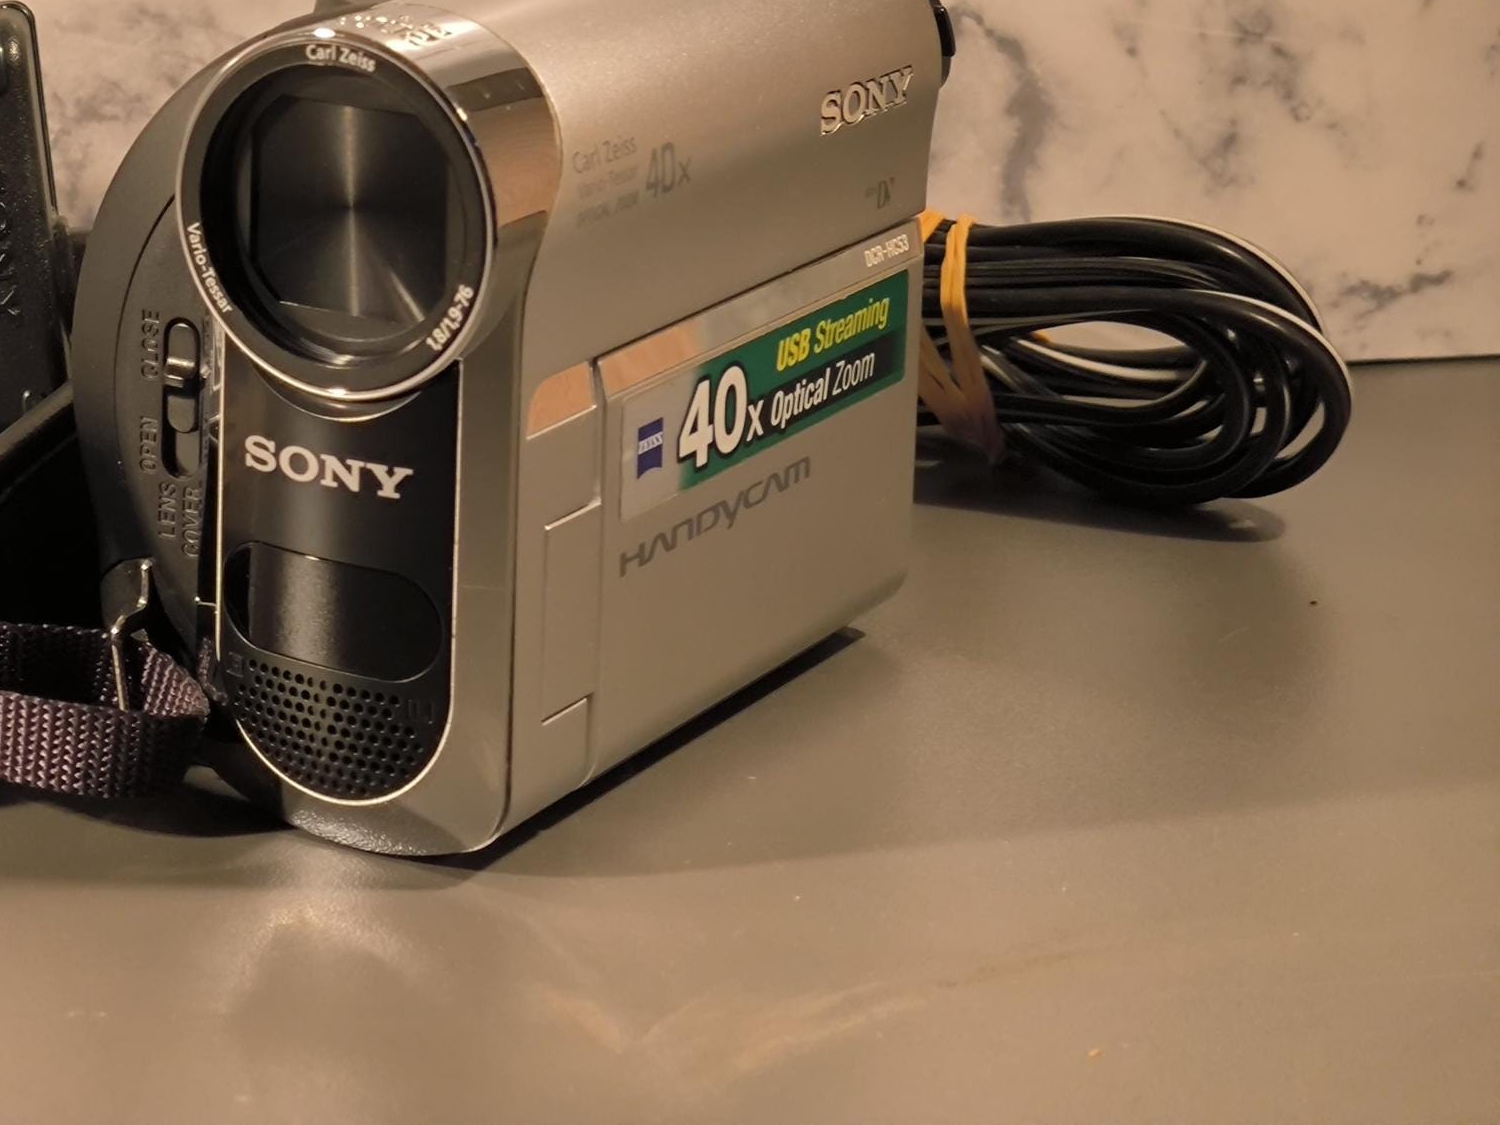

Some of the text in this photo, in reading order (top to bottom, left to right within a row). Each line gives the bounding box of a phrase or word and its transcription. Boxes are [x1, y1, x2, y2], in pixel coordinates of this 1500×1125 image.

[305, 44, 376, 72] Carl Zeiss
[820, 64, 914, 137] SONY
[572, 136, 637, 174] Carl Zeiss
[186, 222, 233, 314] Vario-Tessar
[141, 309, 161, 380] CLOSE
[776, 297, 891, 372] USB Streaming
[771, 367, 831, 429] Optical
[832, 352, 875, 396] Zoom
[139, 417, 160, 473] OPEN
[243, 433, 414, 500] SONY
[158, 482, 177, 540] LENS
[182, 487, 201, 558] COVER
